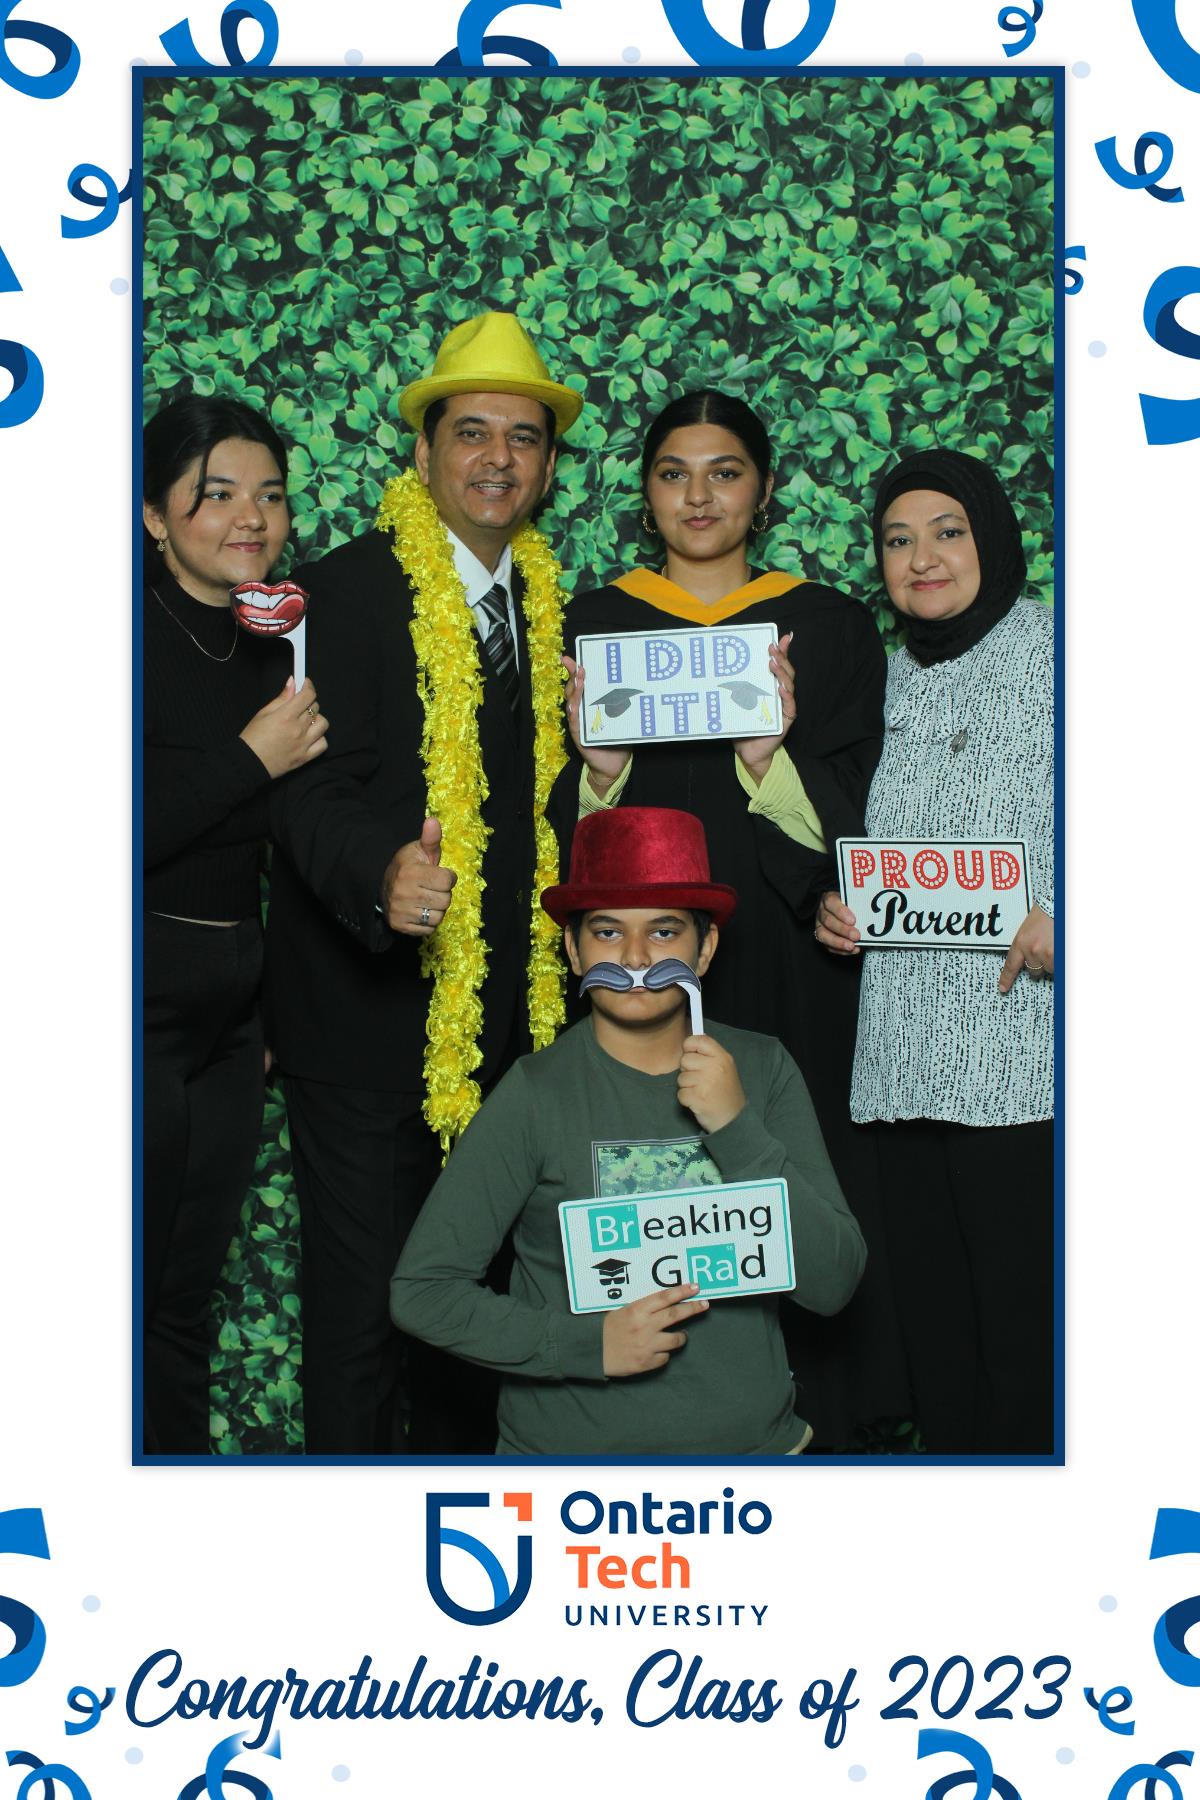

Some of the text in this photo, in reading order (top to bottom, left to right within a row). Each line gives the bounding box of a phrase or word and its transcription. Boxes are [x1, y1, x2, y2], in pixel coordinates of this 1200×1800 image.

[606, 635, 751, 683] I DID
[640, 691, 722, 736] IT!
[850, 849, 1021, 891] PROUD
[867, 889, 1004, 937] Parent
[595, 1203, 772, 1246] Breaking
[651, 1244, 766, 1287] GRad
